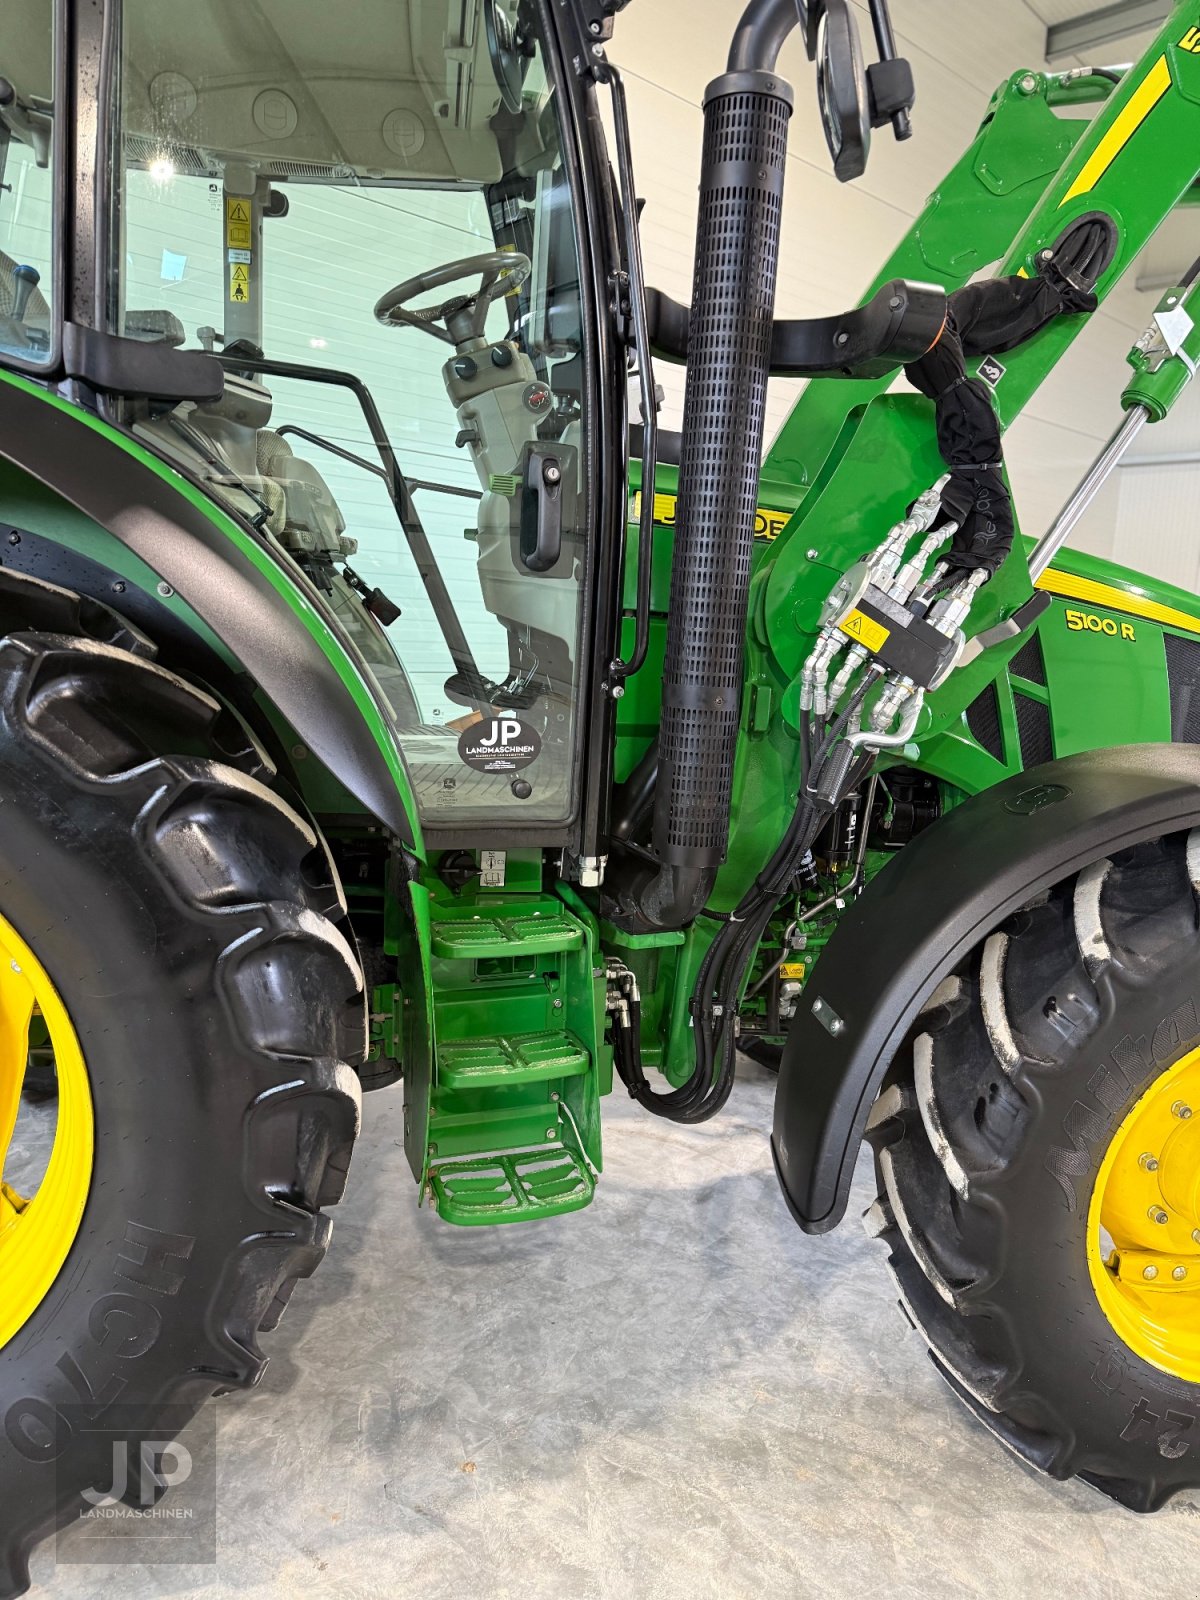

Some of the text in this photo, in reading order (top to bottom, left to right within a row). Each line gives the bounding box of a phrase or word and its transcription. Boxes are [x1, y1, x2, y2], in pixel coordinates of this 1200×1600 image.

[1065, 609, 1136, 642] 5100 R
[480, 721, 521, 746] JP
[466, 746, 534, 754] LANDMASCHINEN
